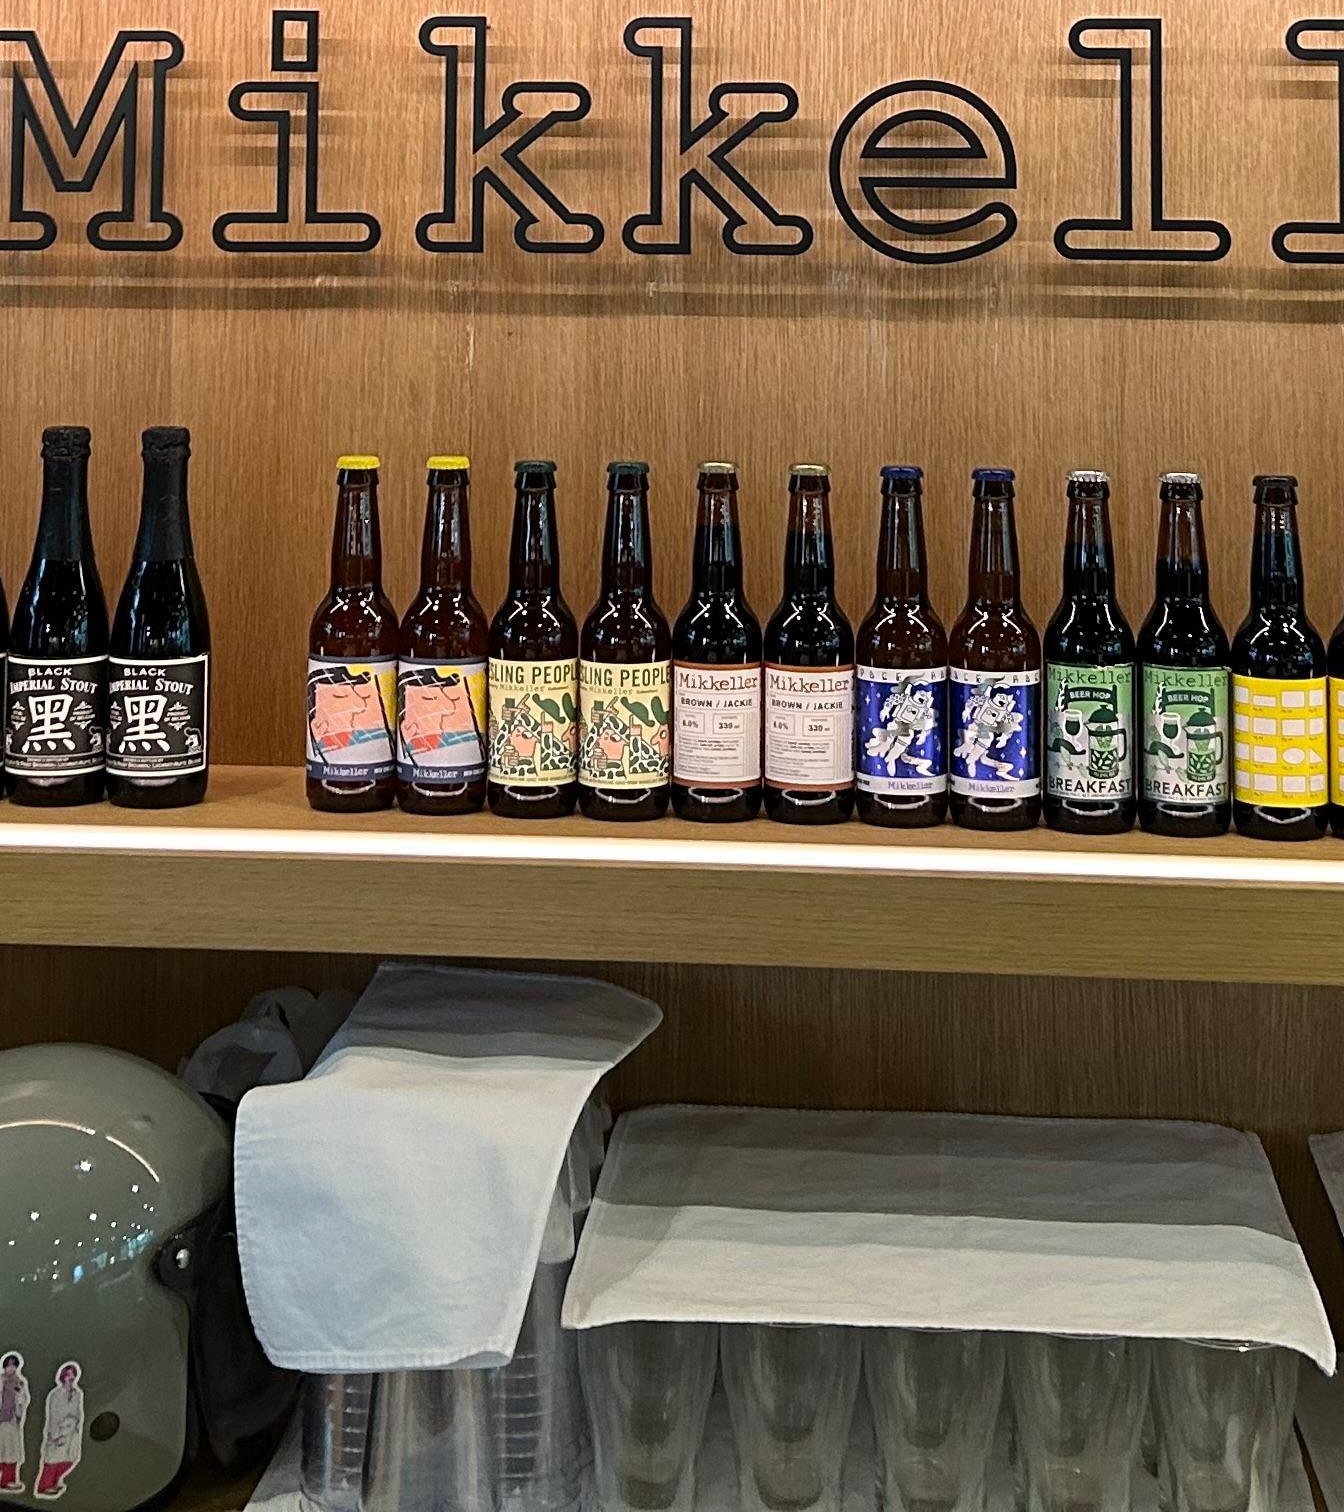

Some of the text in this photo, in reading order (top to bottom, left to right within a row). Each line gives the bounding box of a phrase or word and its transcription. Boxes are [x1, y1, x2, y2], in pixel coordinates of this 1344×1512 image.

[28, 667, 72, 677] BLACK
[123, 667, 167, 677] BLACK
[489, 662, 524, 684] SLING
[581, 665, 613, 687] SLING
[1048, 667, 1131, 685] Mikkeller
[1144, 669, 1227, 688] Mikkeller
[60, 677, 98, 694] STOUT
[154, 677, 194, 696] STOUT
[680, 672, 758, 691] Mikkeller
[770, 674, 849, 693] Mikkeller
[681, 696, 753, 708] BROWN JACKIE
[1069, 690, 1091, 699] BEER
[1167, 694, 1189, 703] BEER
[771, 699, 843, 711] BROWN JACKIE
[21, 694, 76, 753] 黑
[118, 694, 170, 754] 黑
[323, 766, 369, 776] Mikkeller
[412, 768, 458, 779] Mikkeller
[1049, 776, 1131, 793] BREAKFAST
[1144, 780, 1227, 798] BREAKFAST
